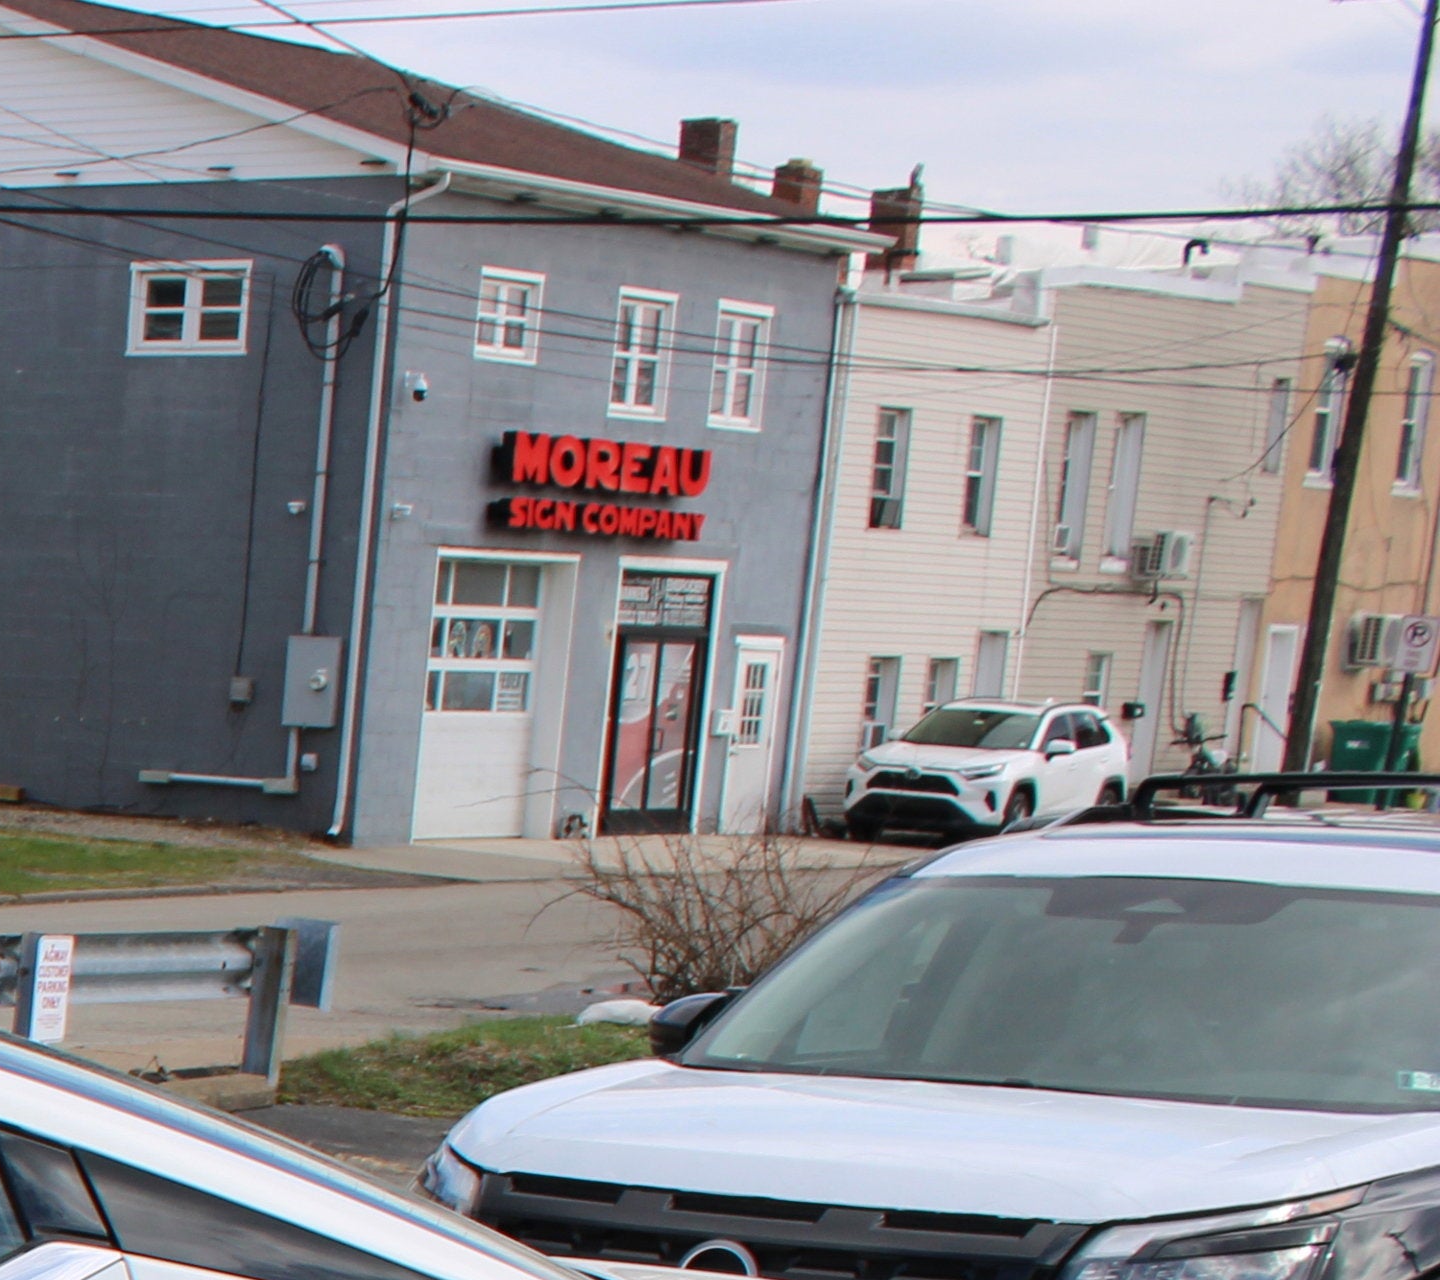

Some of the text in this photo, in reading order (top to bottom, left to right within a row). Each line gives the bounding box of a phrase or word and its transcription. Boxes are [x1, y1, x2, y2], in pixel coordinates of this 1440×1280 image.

[513, 431, 712, 497] MOREAU
[509, 496, 707, 541] SIGN COMPANY
[38, 965, 69, 977] CUSTOMER
[37, 980, 68, 993] PARKING
[41, 996, 61, 1009] ONLY
